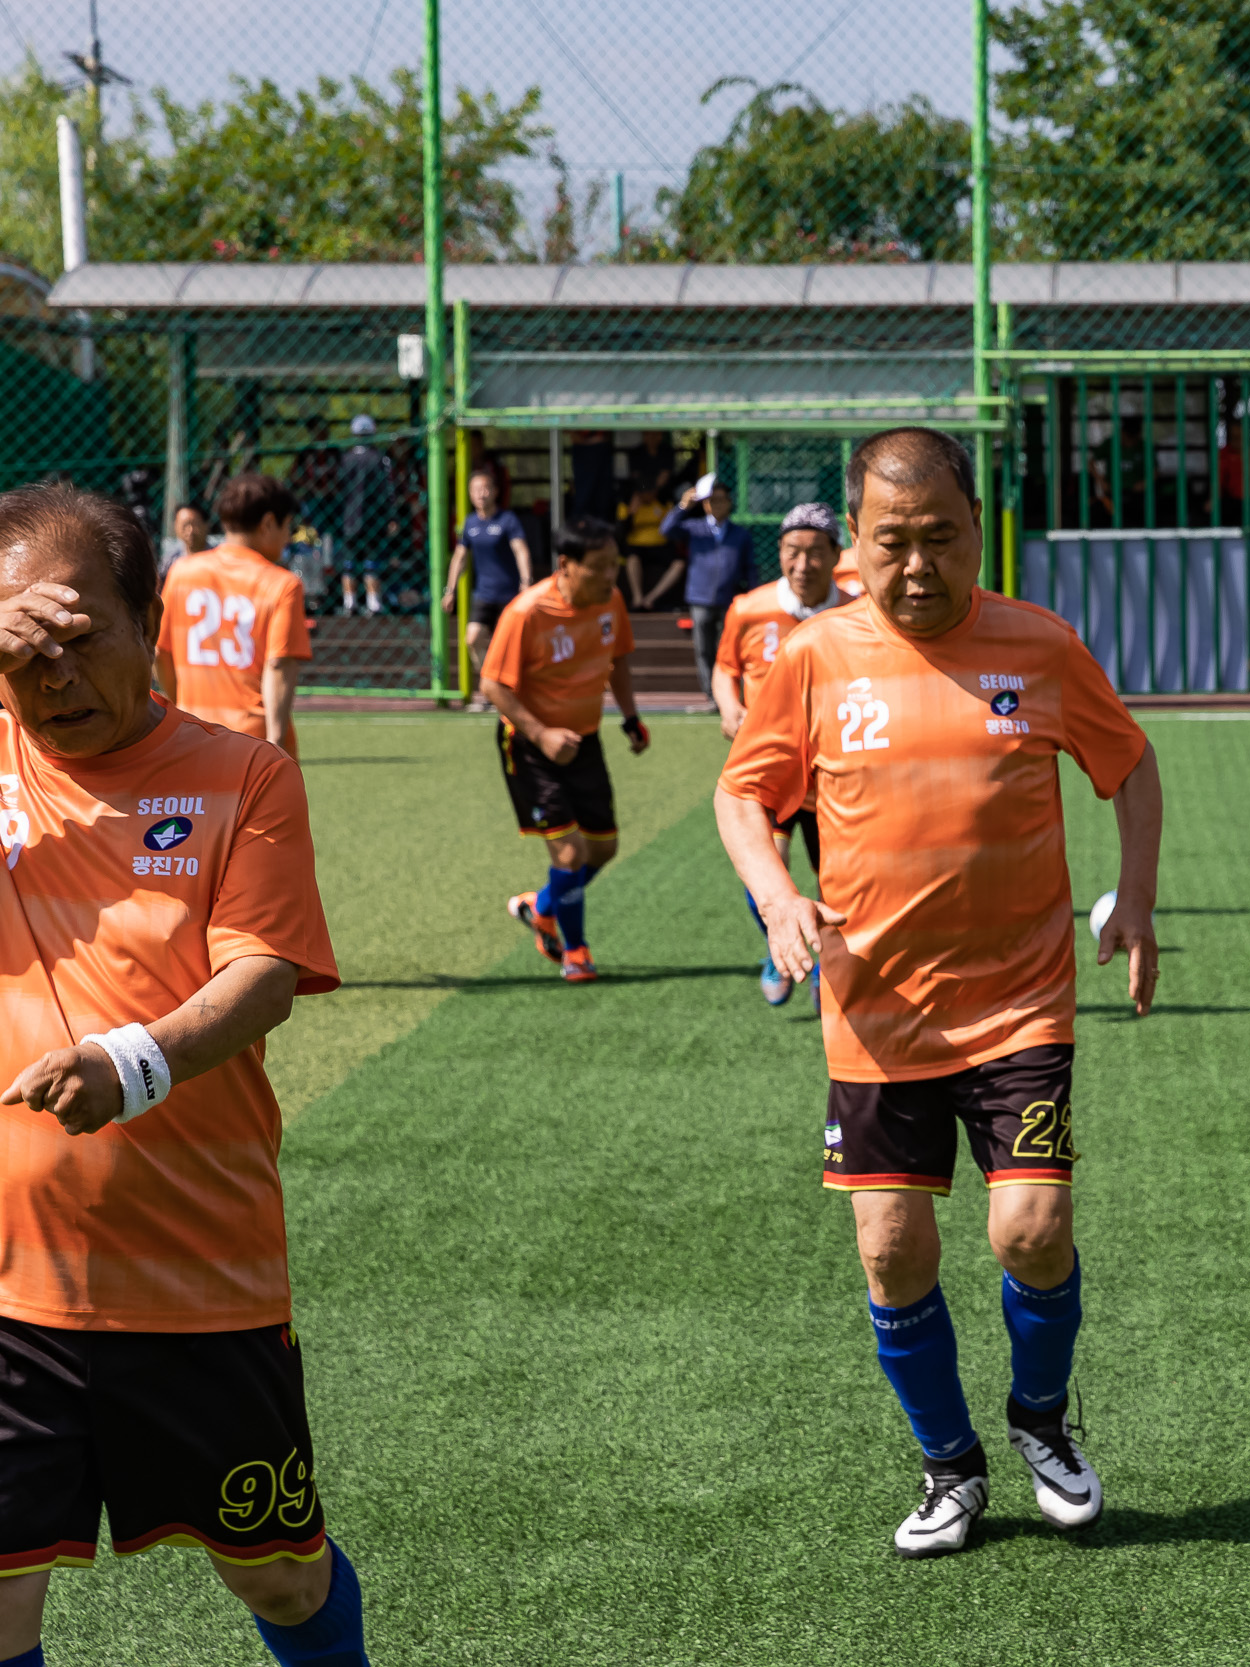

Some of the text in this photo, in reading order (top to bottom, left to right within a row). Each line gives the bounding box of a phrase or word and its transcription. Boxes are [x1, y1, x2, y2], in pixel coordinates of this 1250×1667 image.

[185, 587, 256, 669] 23
[550, 634, 575, 663] 10
[979, 674, 1026, 691] SEOUL
[837, 699, 890, 753] 22
[137, 796, 205, 816] SEOUL
[132, 855, 200, 877] 광진70
[218, 1447, 316, 1532] 99
